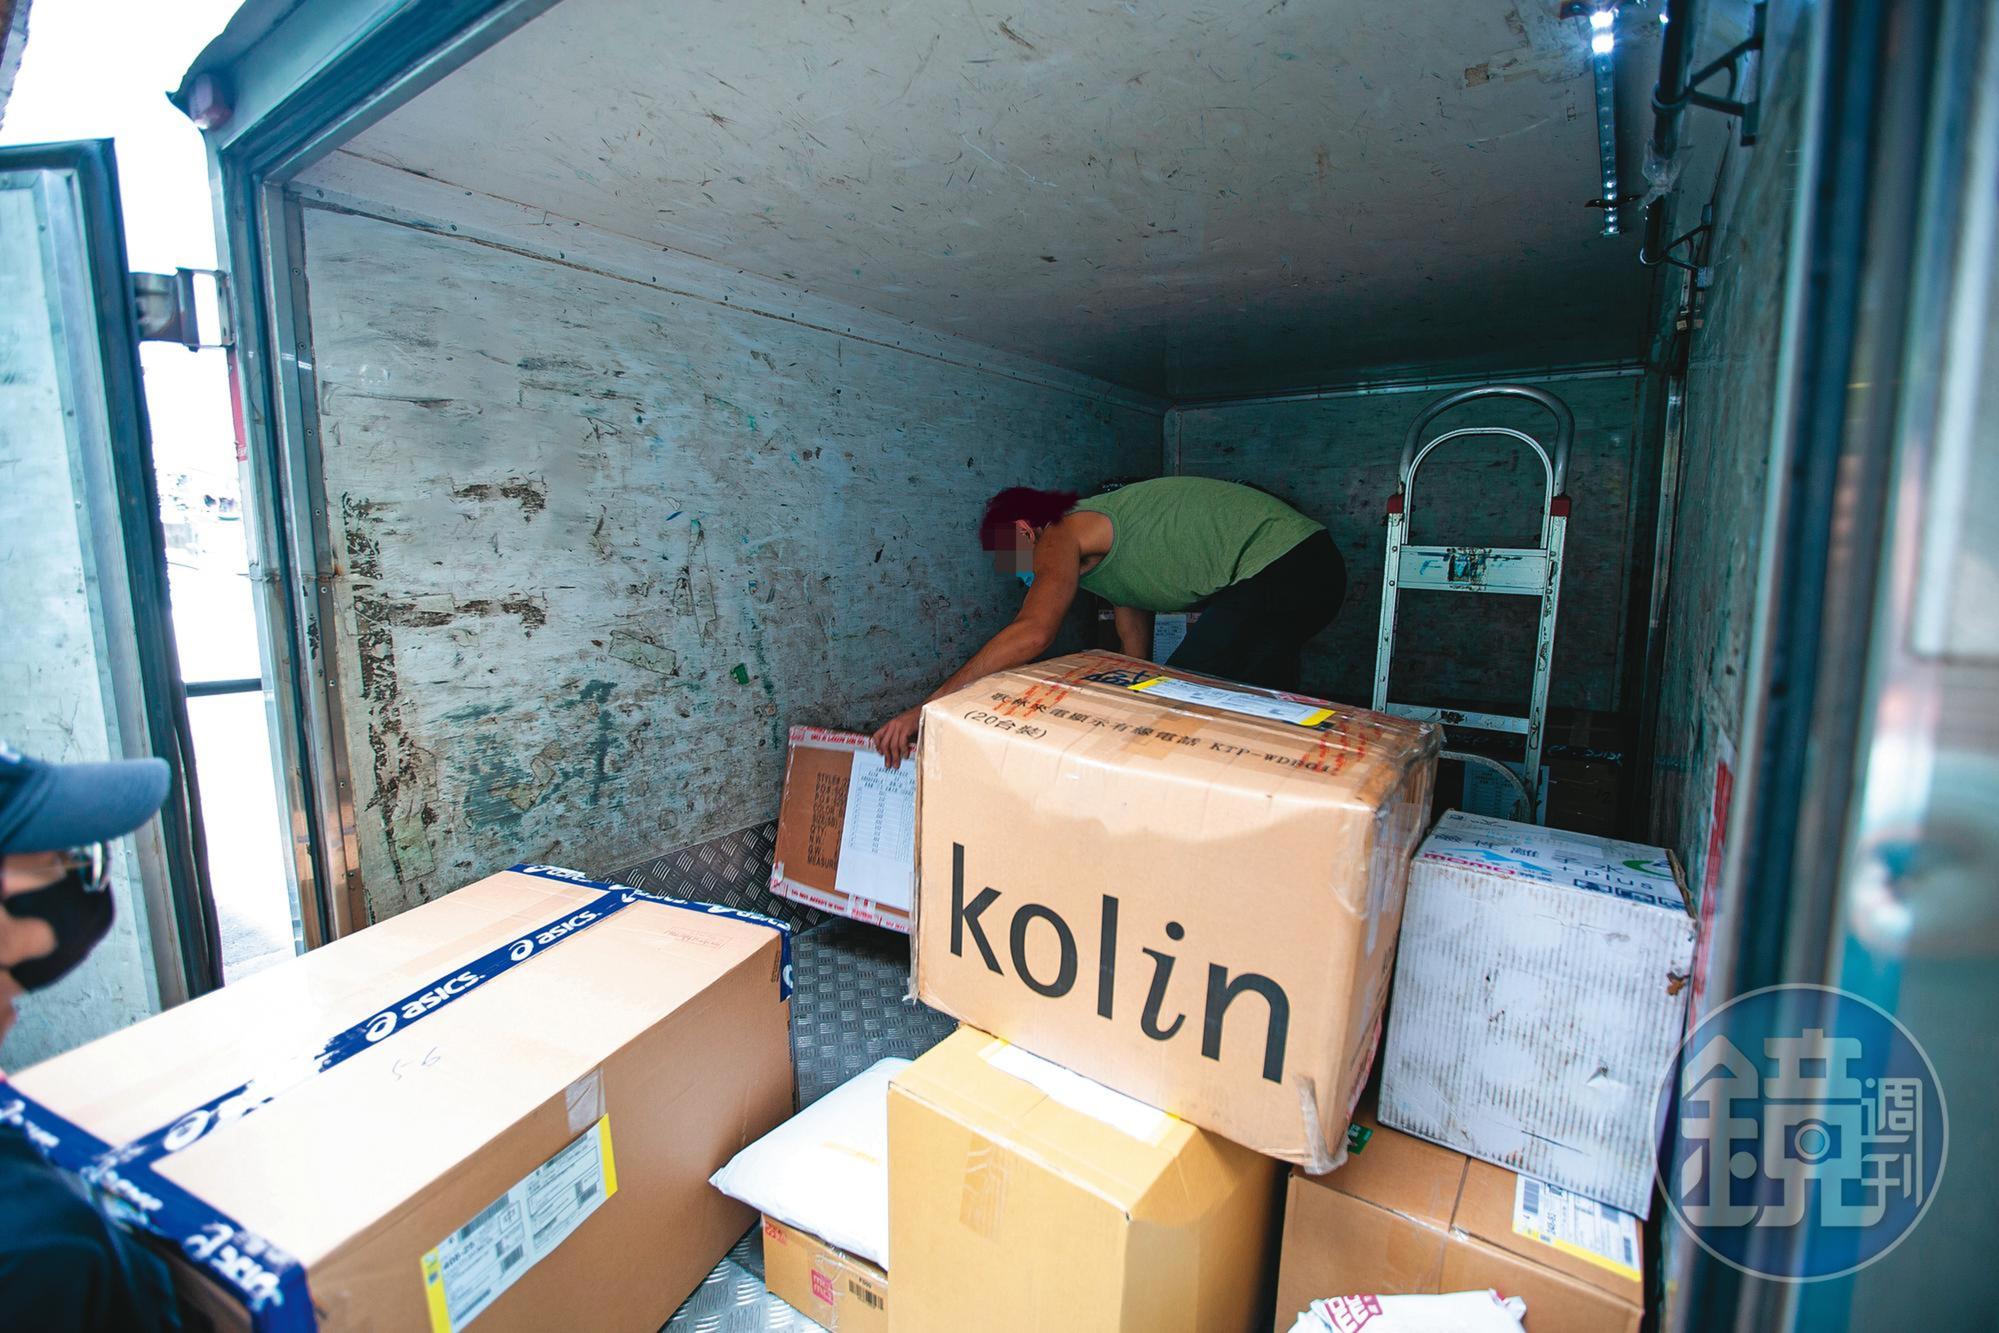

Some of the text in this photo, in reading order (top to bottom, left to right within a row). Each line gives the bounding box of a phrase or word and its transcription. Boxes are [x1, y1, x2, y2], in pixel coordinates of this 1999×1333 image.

[964, 709, 1048, 741] (20台裝)
[536, 908, 601, 946] asics
[949, 841, 1291, 1085] kolin
[401, 969, 485, 1020] asics
